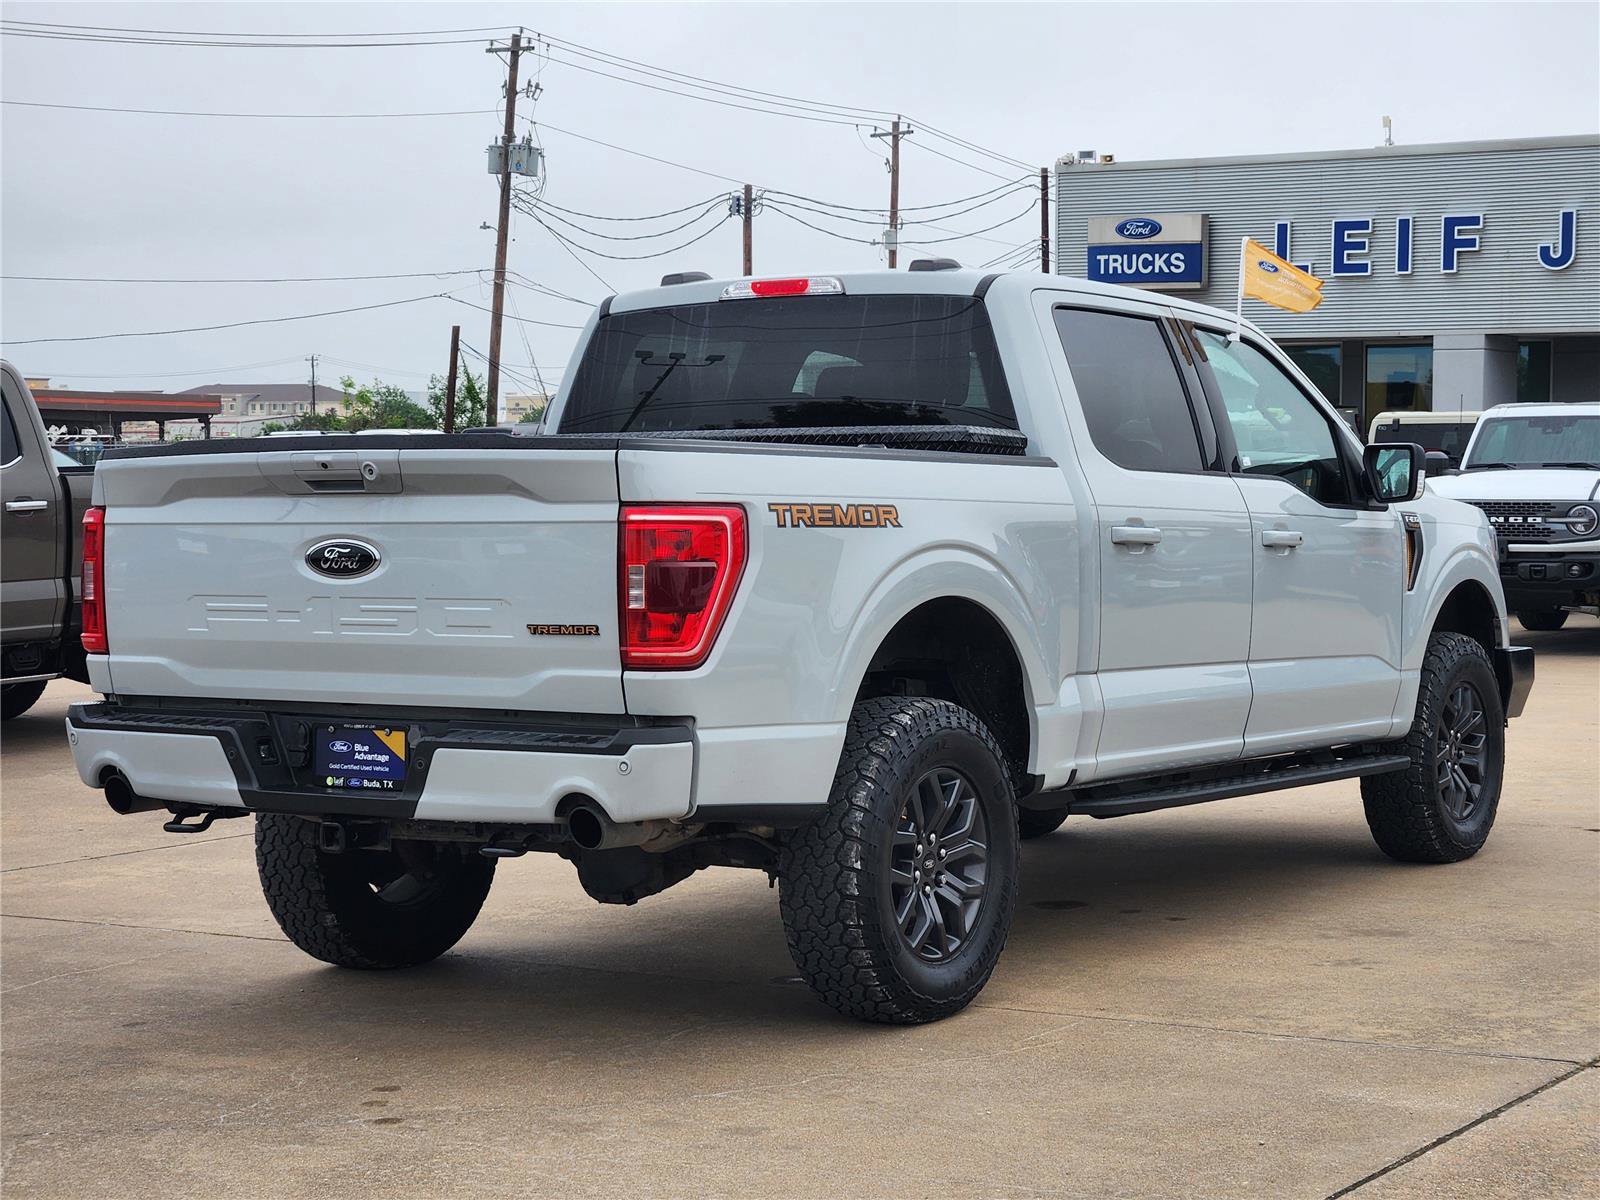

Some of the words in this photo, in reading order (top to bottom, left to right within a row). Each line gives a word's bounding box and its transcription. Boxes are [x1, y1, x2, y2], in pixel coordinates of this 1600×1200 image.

[1275, 214, 1484, 277] LEIF
[1537, 209, 1577, 270] J
[1096, 252, 1186, 275] TRUCKS
[1260, 261, 1276, 272] Ford
[767, 502, 904, 528] TREMOR
[320, 547, 361, 569] Ford
[187, 594, 515, 638] F-150
[526, 623, 601, 636] TREMOR
[354, 743, 369, 751] Blue
[354, 752, 389, 762] Advantage
[363, 779, 382, 789] Buda,
[383, 780, 394, 789] TX
